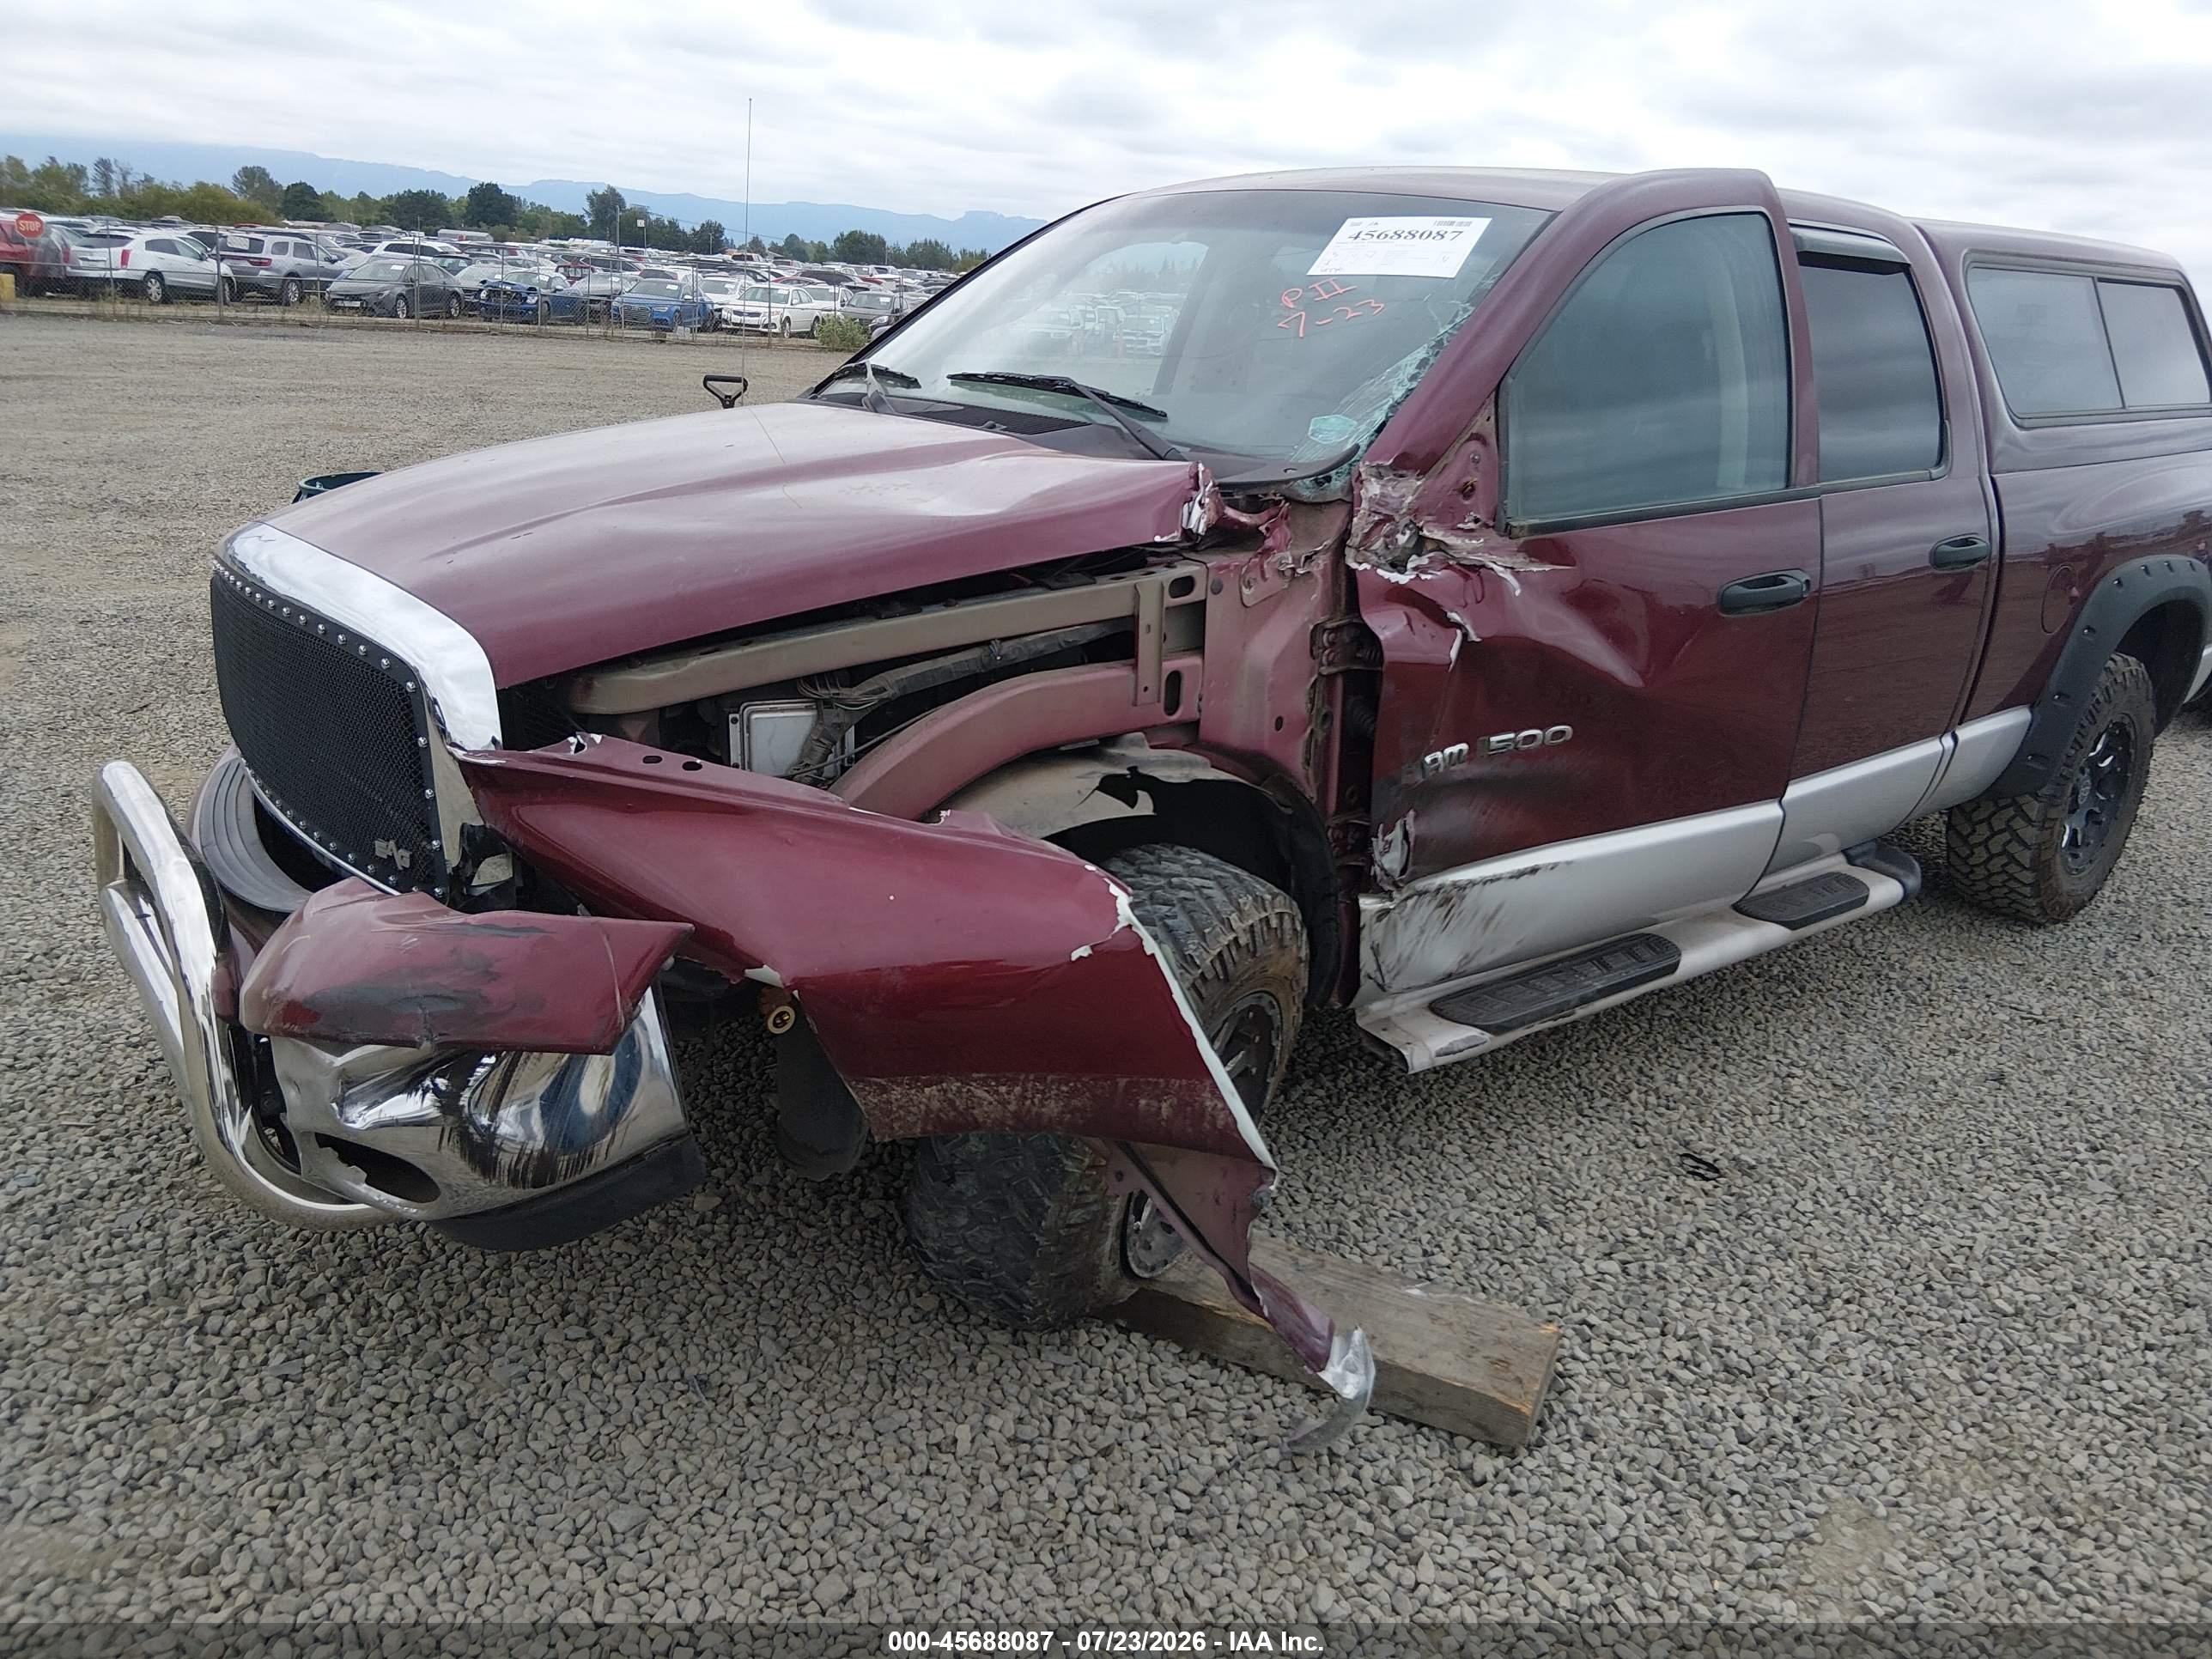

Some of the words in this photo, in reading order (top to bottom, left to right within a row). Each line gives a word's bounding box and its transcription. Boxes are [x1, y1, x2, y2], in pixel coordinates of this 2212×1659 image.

[19, 220, 41, 232] STOP
[1347, 229, 1464, 241] 45688087
[1278, 299, 1385, 338] 7-23
